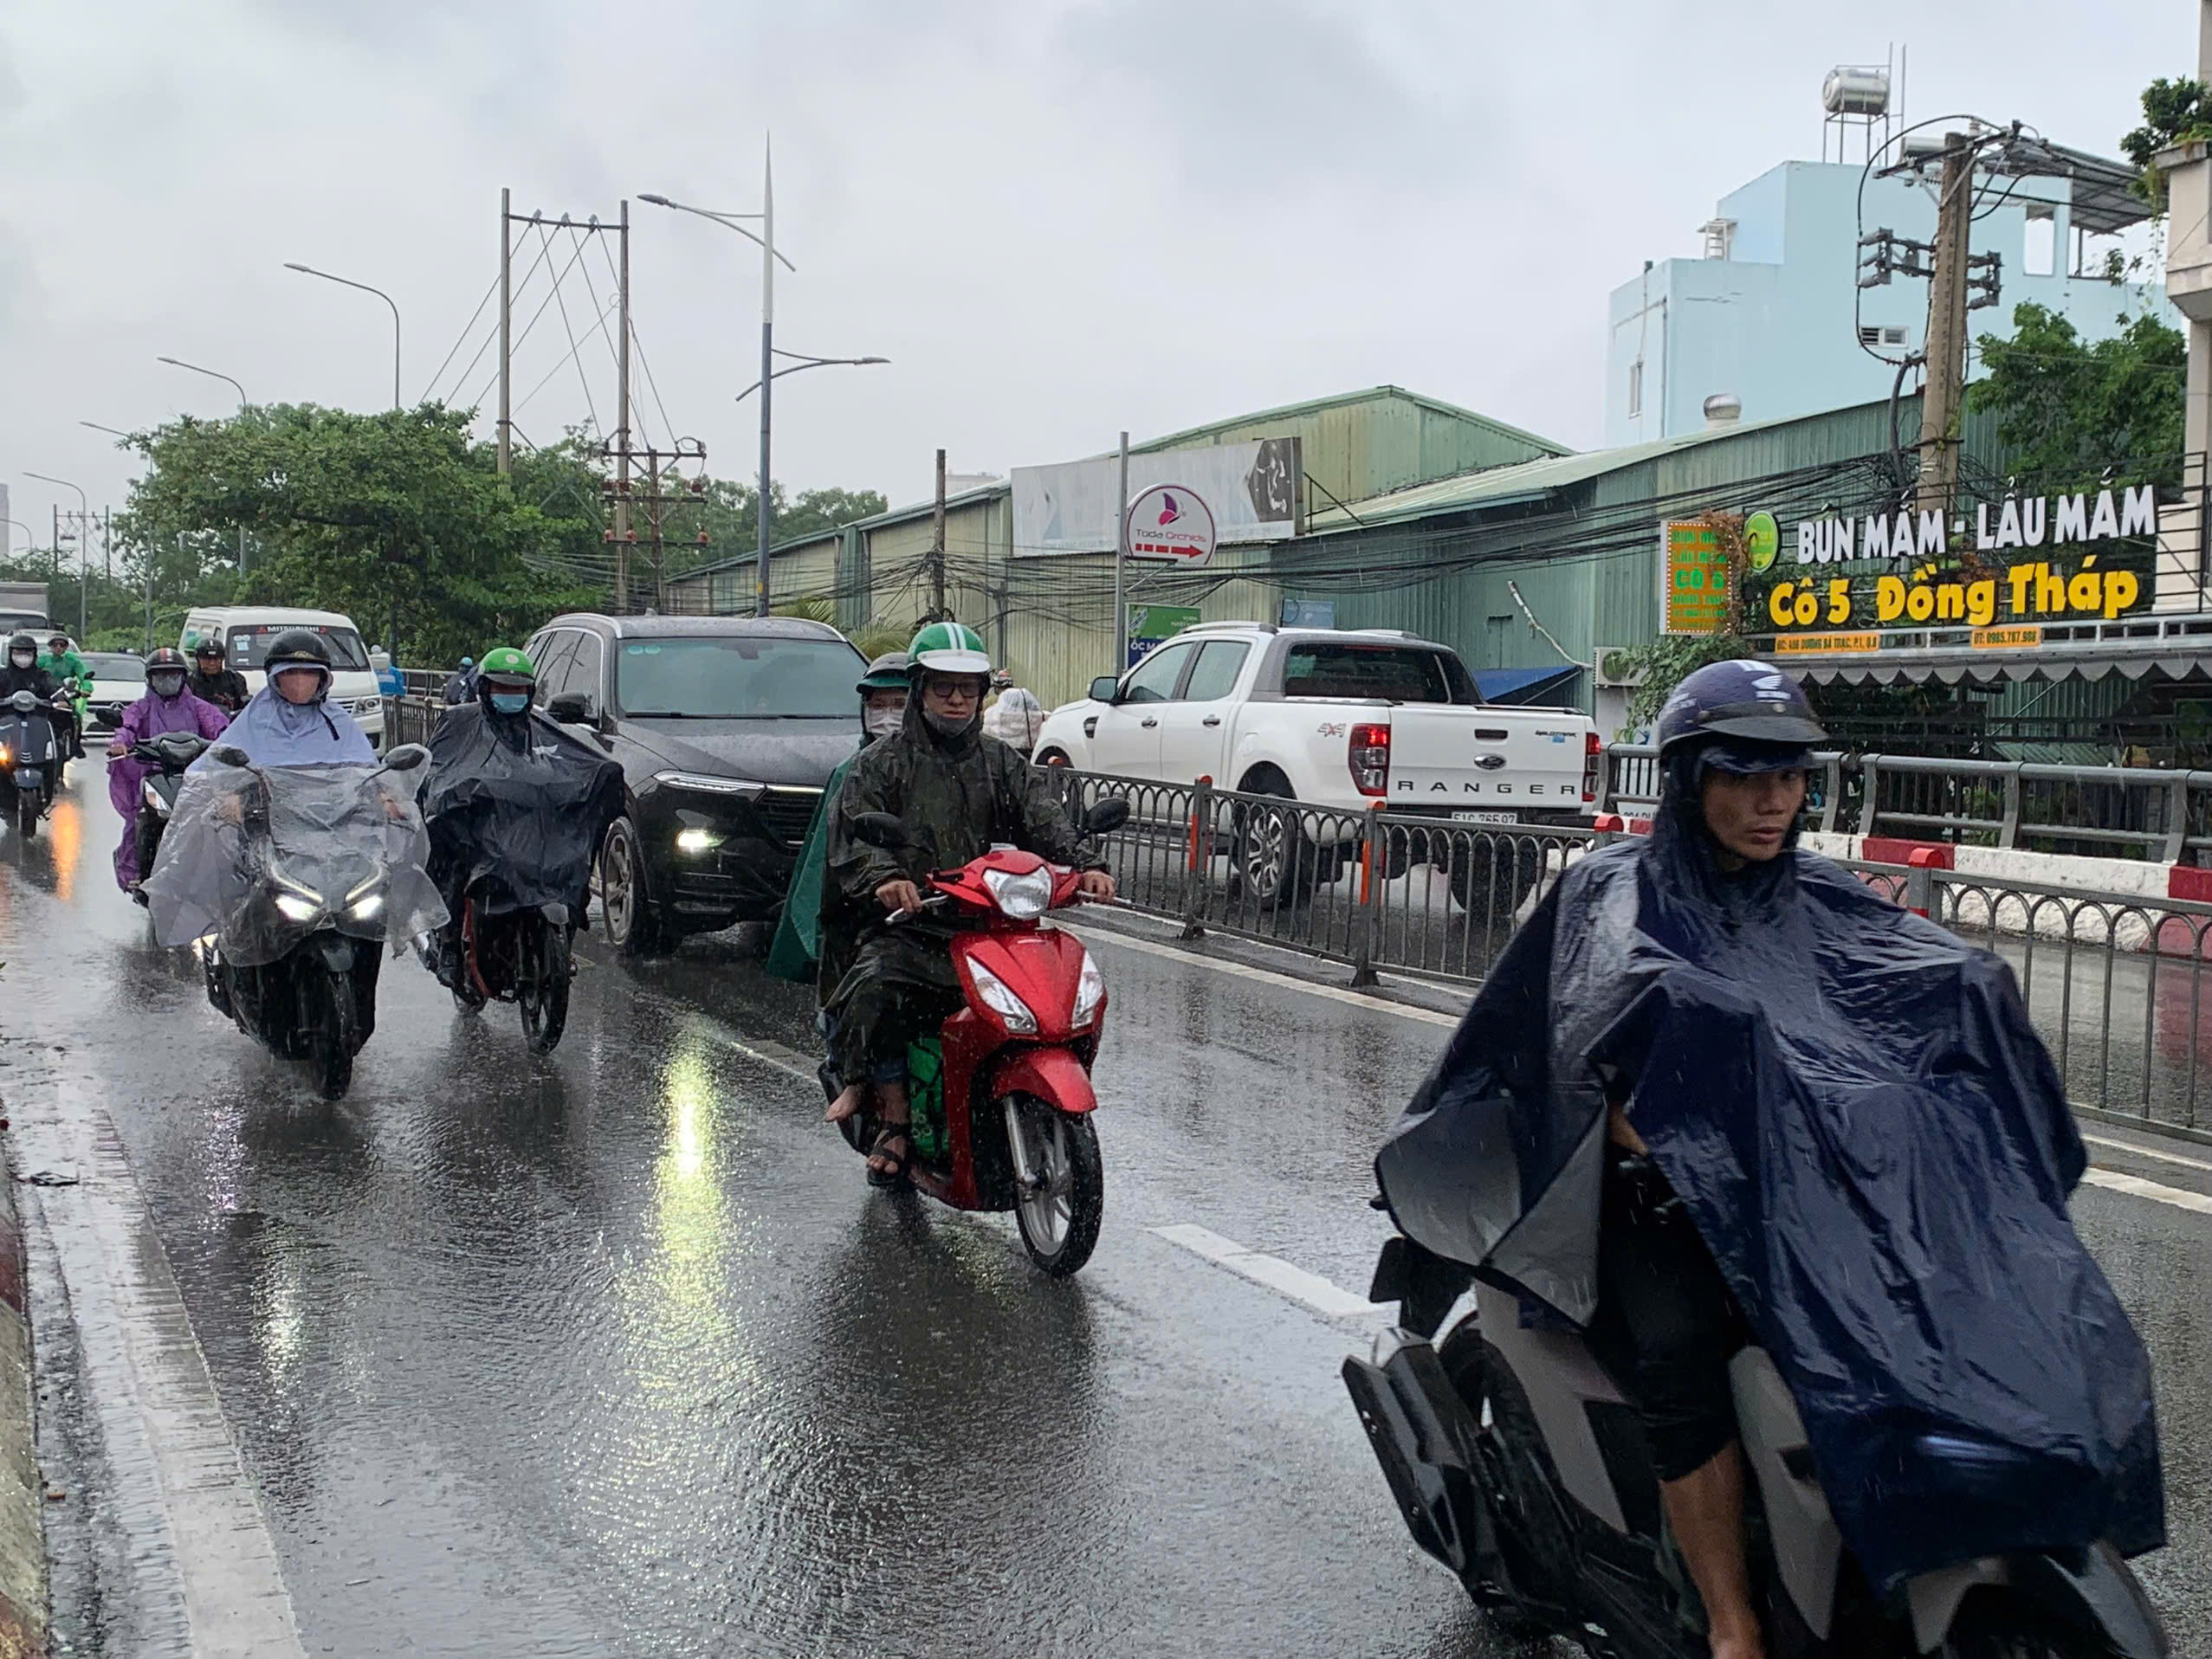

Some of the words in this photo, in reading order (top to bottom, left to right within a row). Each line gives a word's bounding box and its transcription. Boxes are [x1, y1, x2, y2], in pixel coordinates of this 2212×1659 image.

[1798, 501, 1854, 564] BÚN
[1977, 475, 2046, 550] LẨU
[2054, 466, 2156, 544] MẮM
[1769, 577, 1818, 627] Cô
[1827, 578, 1851, 624] 5
[1876, 563, 1995, 626] Đồng
[2008, 554, 2138, 619] Tháp
[1397, 780, 1575, 795] RANGER
